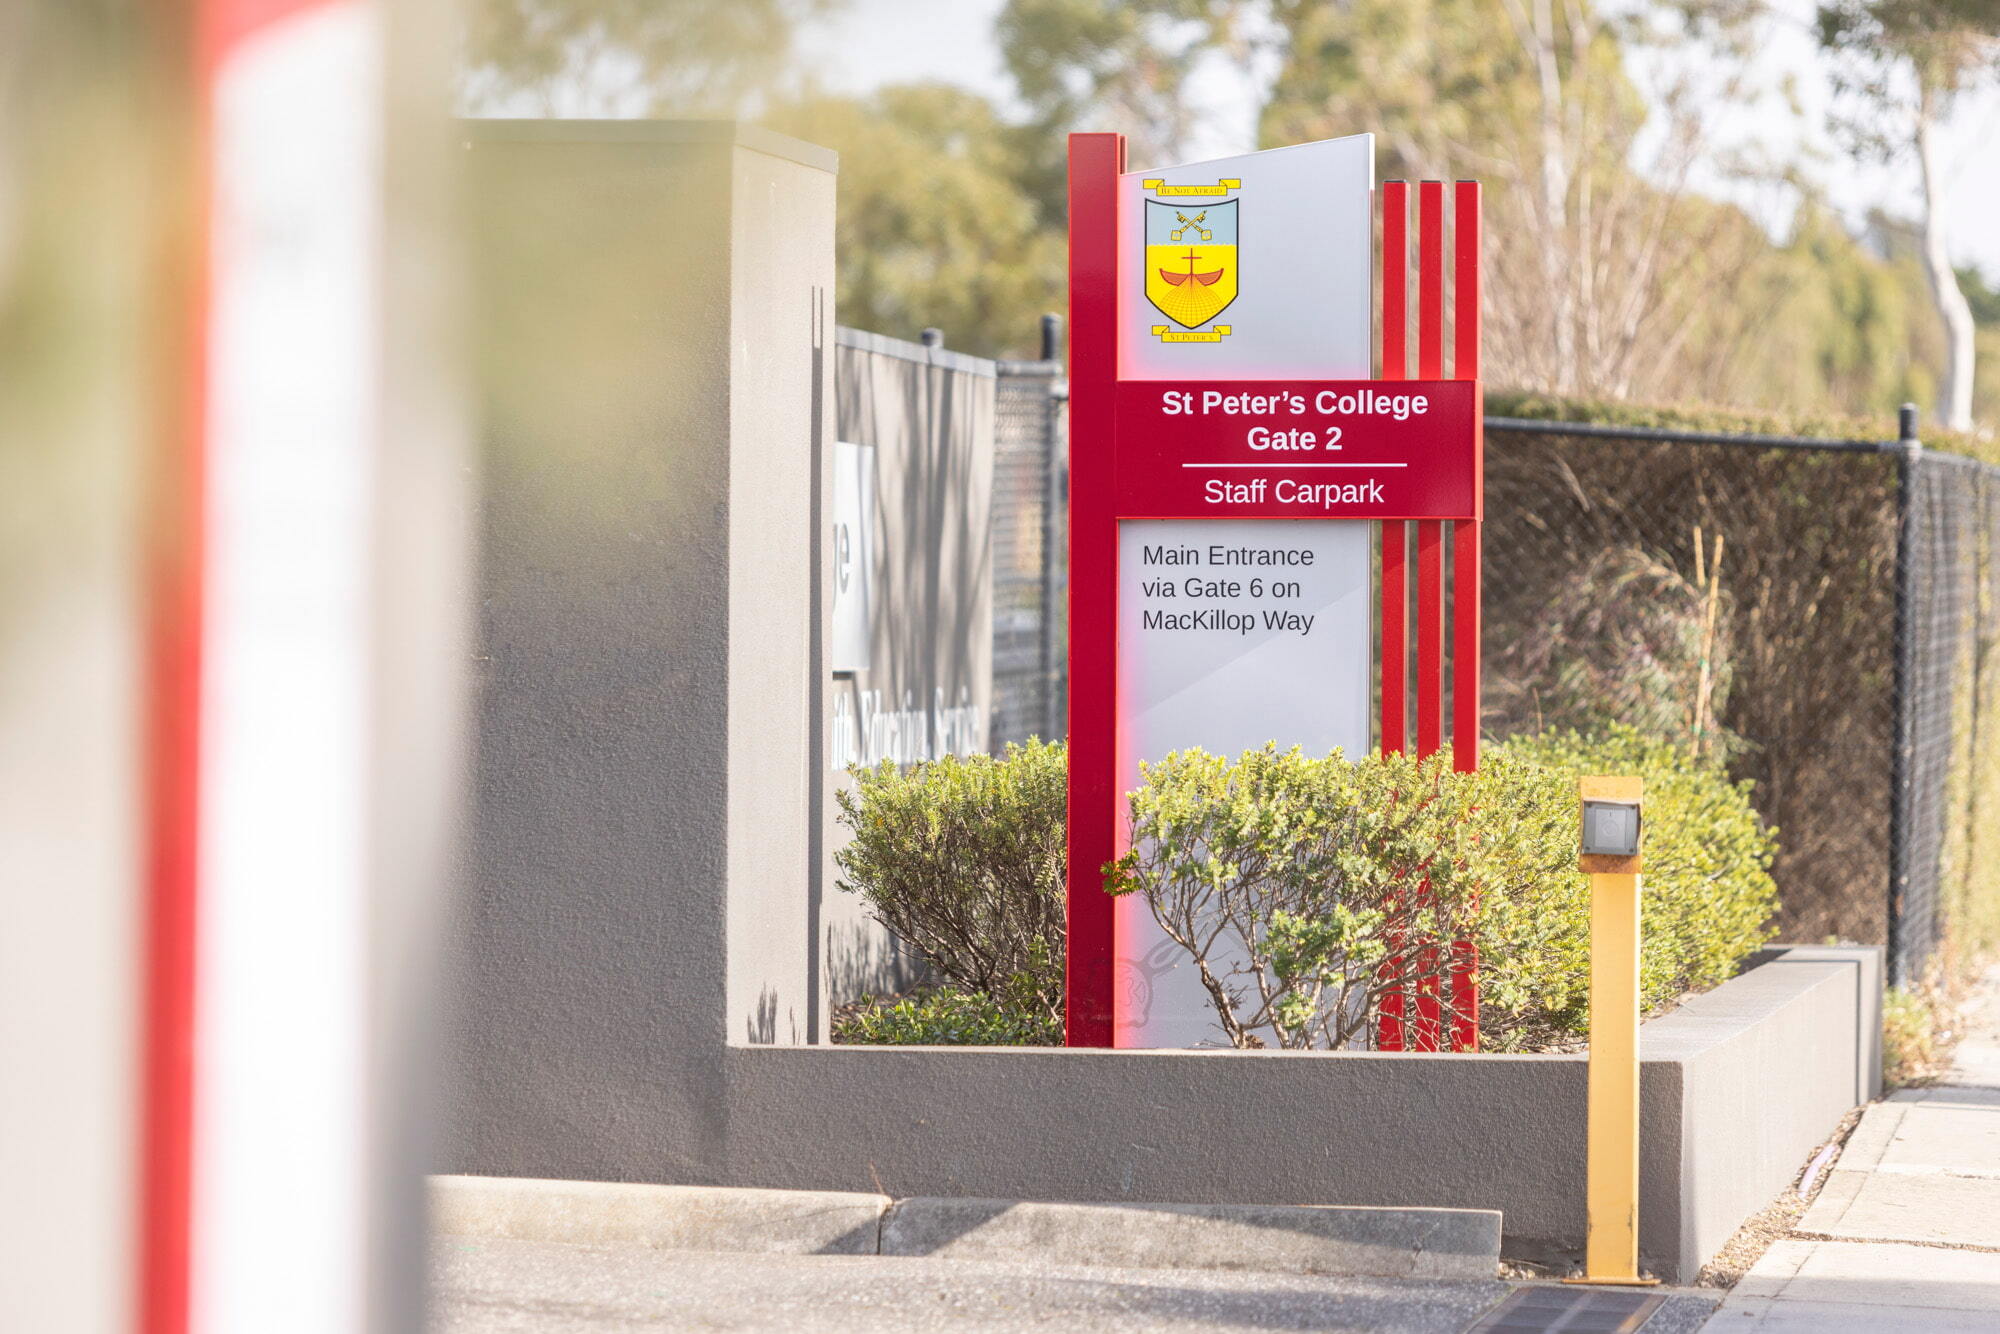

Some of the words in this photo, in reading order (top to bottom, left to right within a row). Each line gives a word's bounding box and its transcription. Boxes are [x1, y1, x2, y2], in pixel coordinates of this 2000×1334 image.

[1161, 390, 1194, 415] St
[1202, 390, 1306, 415] Peter’s
[1315, 389, 1429, 420] College
[1247, 426, 1317, 451] Gate
[1325, 426, 1343, 451] 2
[1204, 478, 1267, 504] Staff
[1275, 478, 1385, 509] Carpark
[1143, 545, 1199, 566] Main
[1209, 545, 1314, 566] Entrance
[1142, 577, 1176, 598] via
[1184, 578, 1241, 598] Gate
[1250, 578, 1264, 598] 6
[1272, 582, 1300, 598] on
[1143, 609, 1255, 635] MacKillop
[1262, 610, 1315, 635] Way
